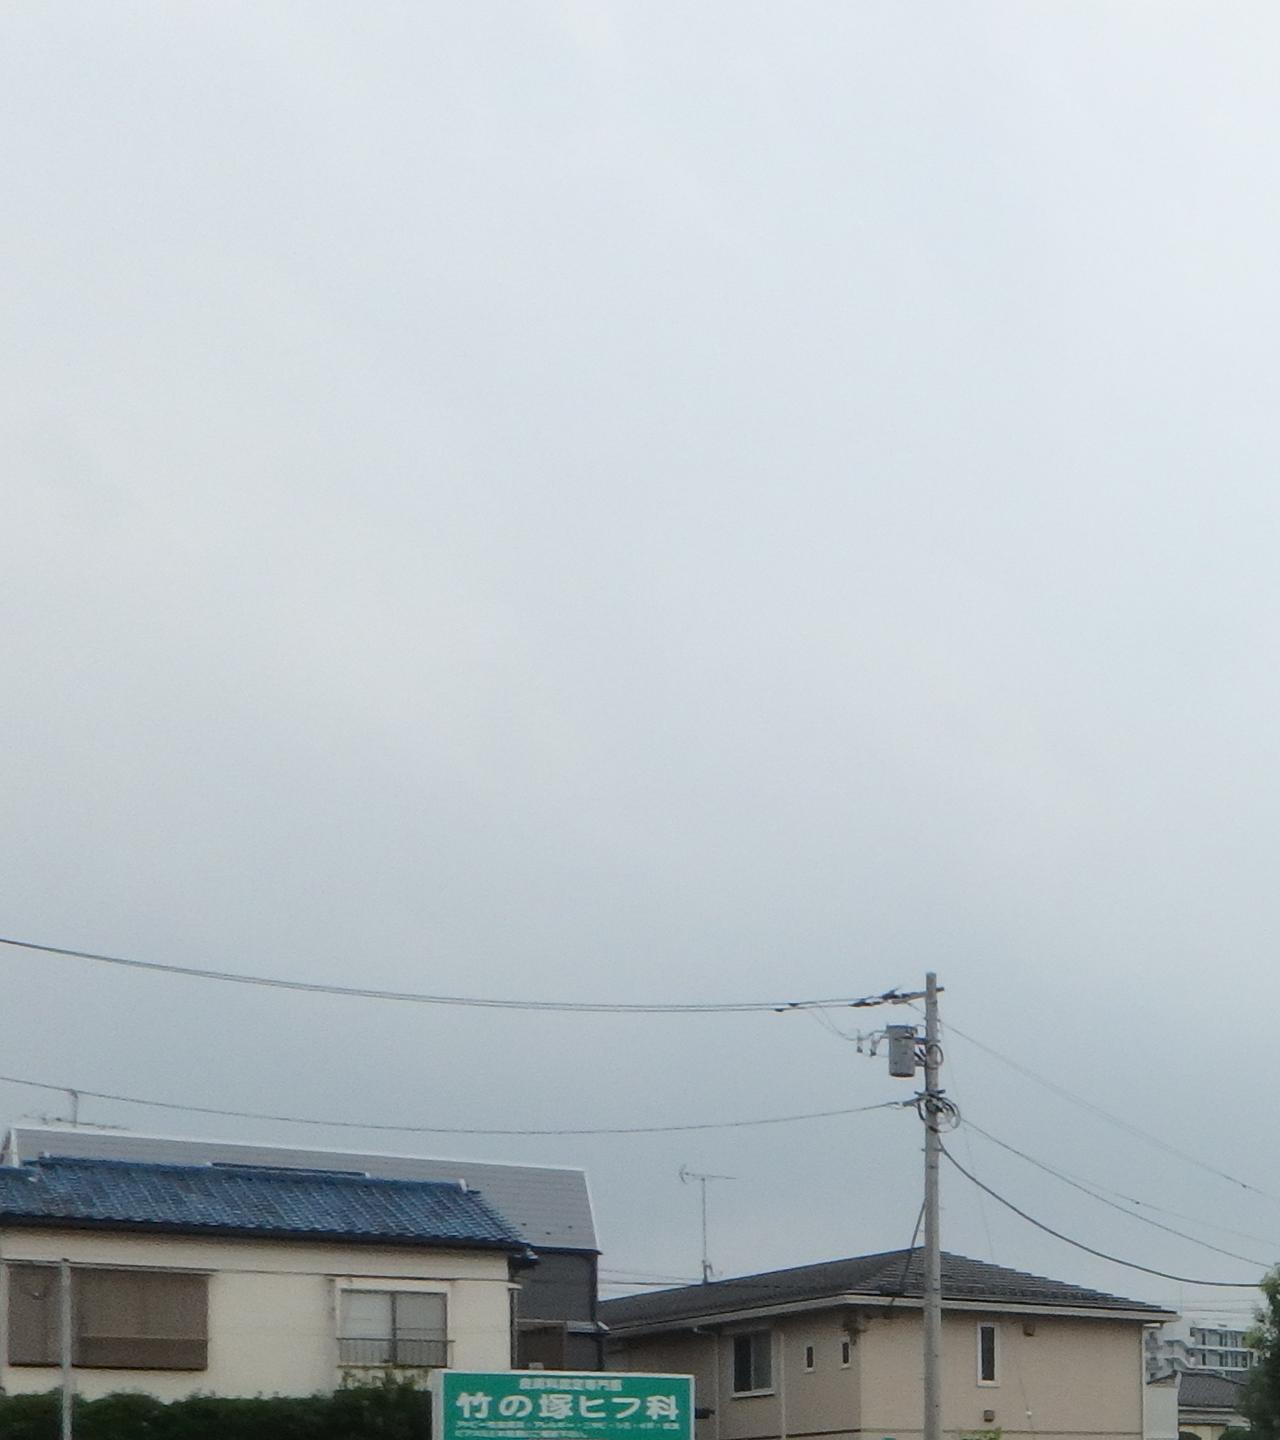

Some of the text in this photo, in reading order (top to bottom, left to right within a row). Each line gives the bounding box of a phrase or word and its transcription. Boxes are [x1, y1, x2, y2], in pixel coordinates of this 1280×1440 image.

[456, 1392, 679, 1420] 竹の塚ヒフ科
